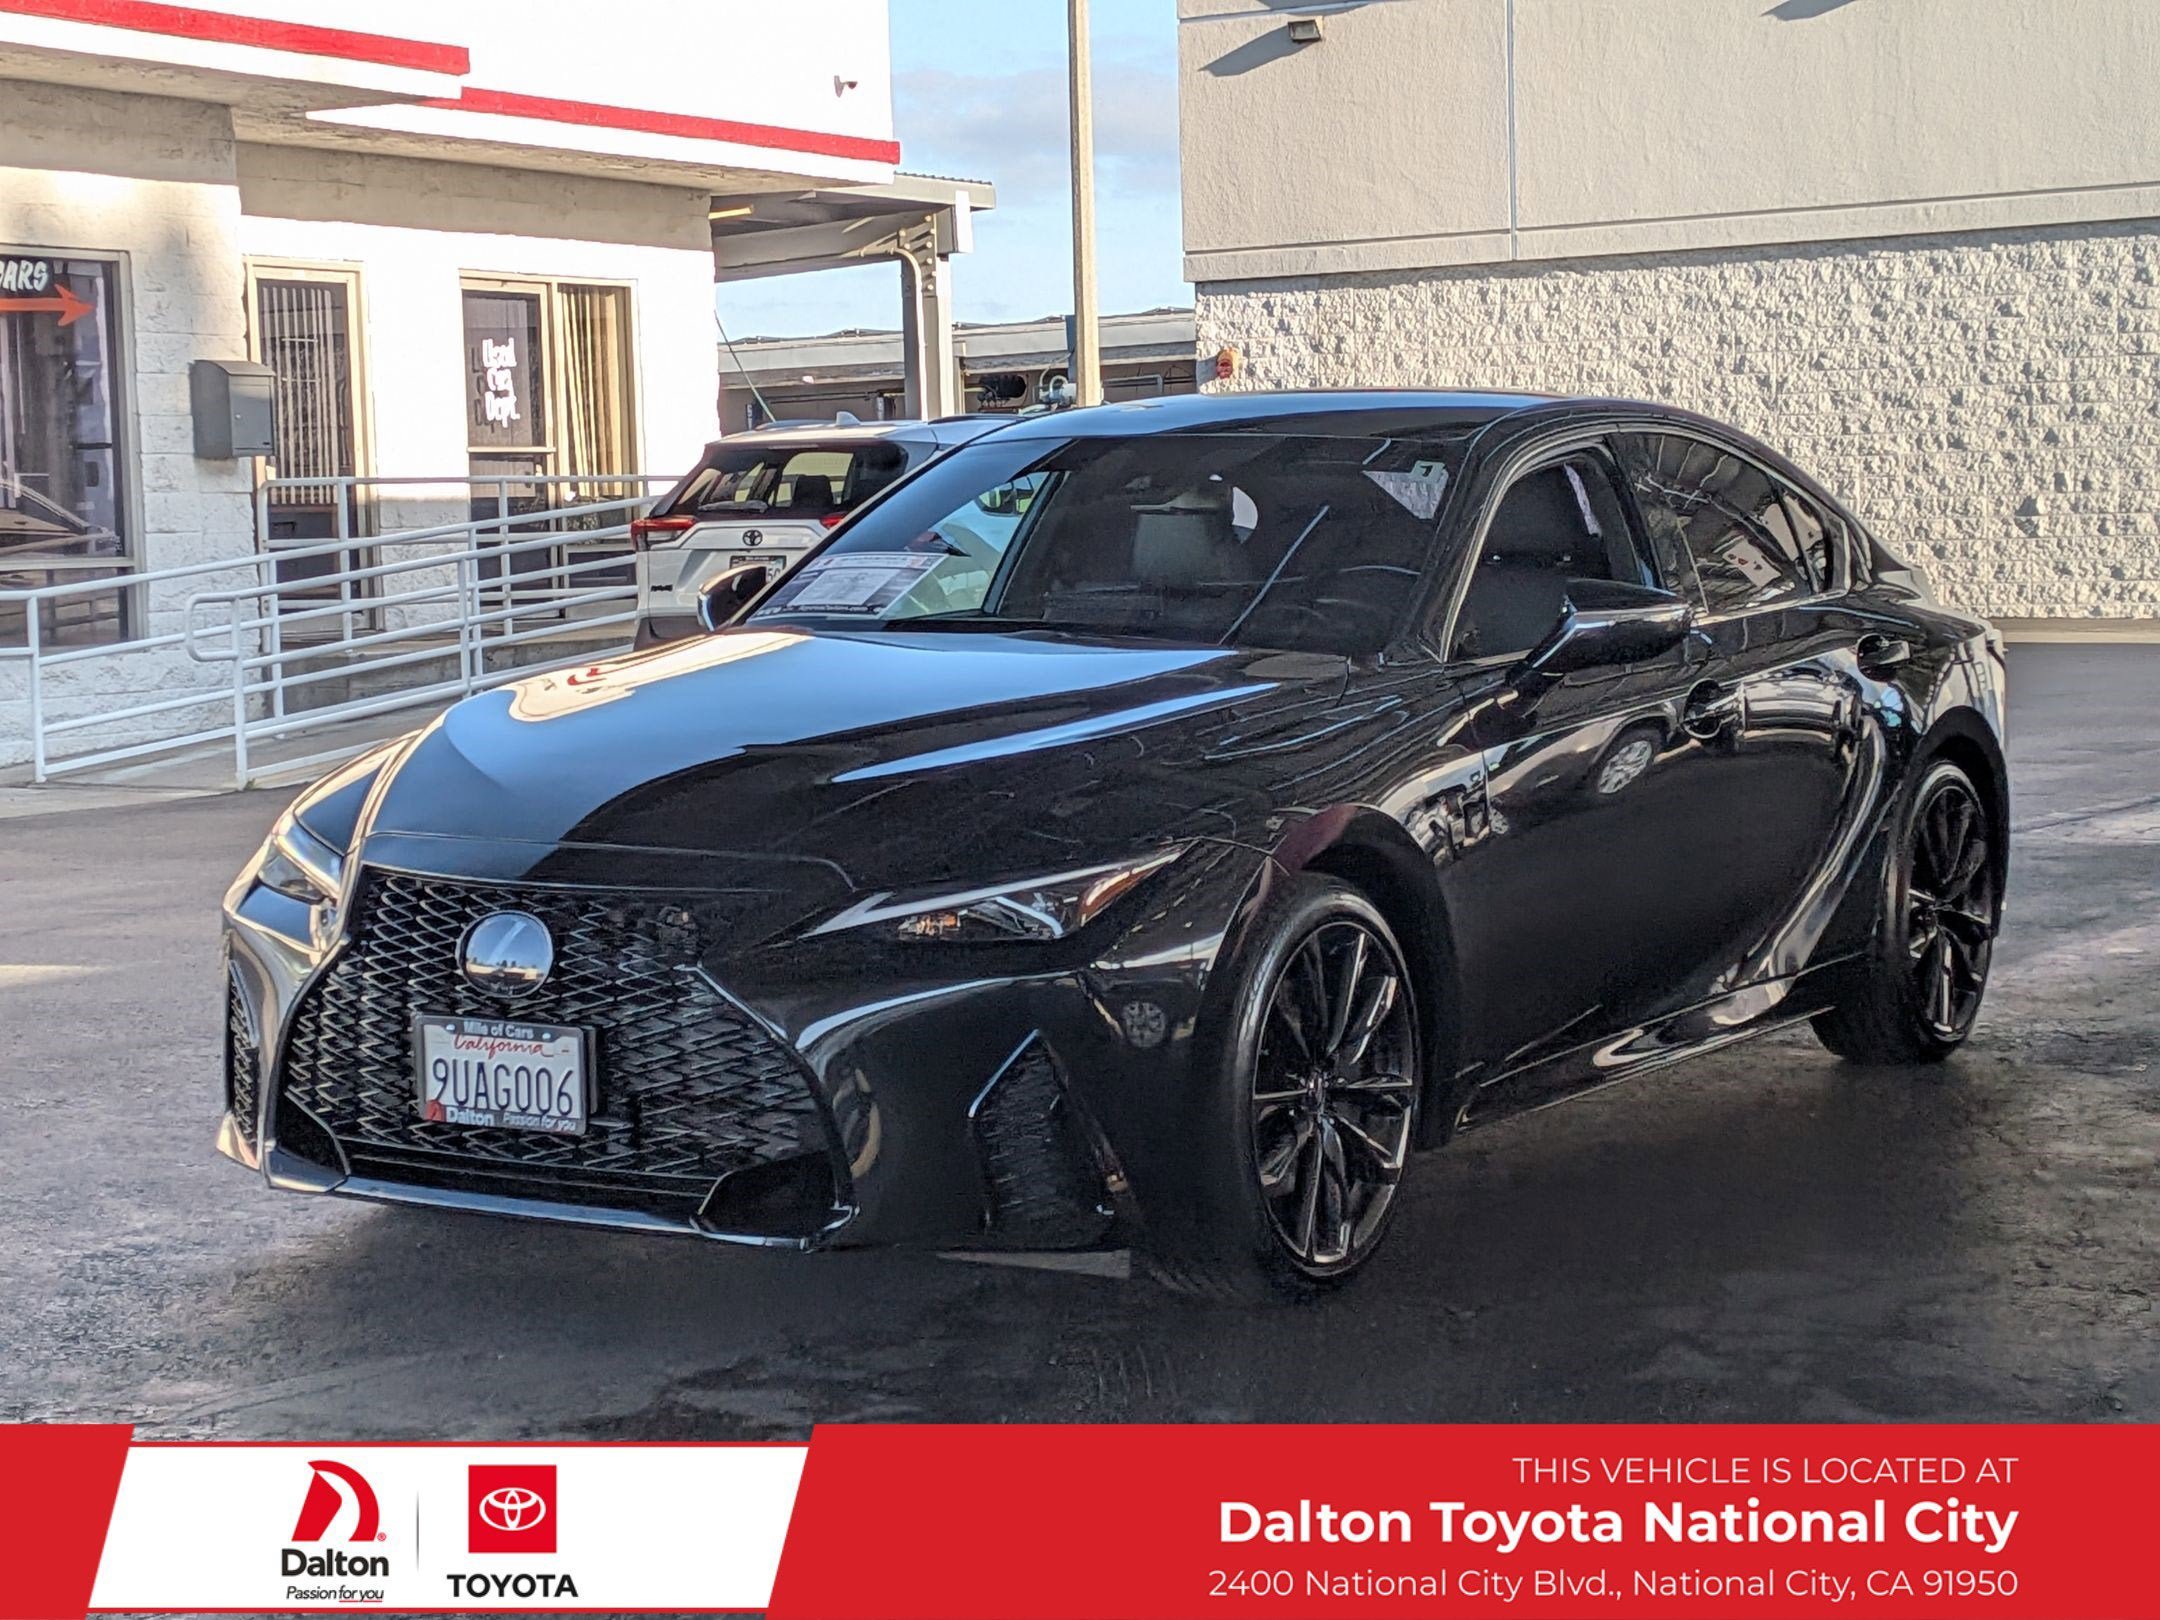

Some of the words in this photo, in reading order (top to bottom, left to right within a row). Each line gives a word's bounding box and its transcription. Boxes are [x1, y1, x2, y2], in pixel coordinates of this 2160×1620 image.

[463, 1020, 488, 1036] Mile
[491, 1023, 504, 1037] of
[505, 1024, 534, 1040] Cars
[454, 1033, 554, 1059] California
[432, 1058, 574, 1116] 9UAG006
[446, 1106, 494, 1127] Dalton
[503, 1112, 539, 1128] Passion
[540, 1114, 556, 1129] for
